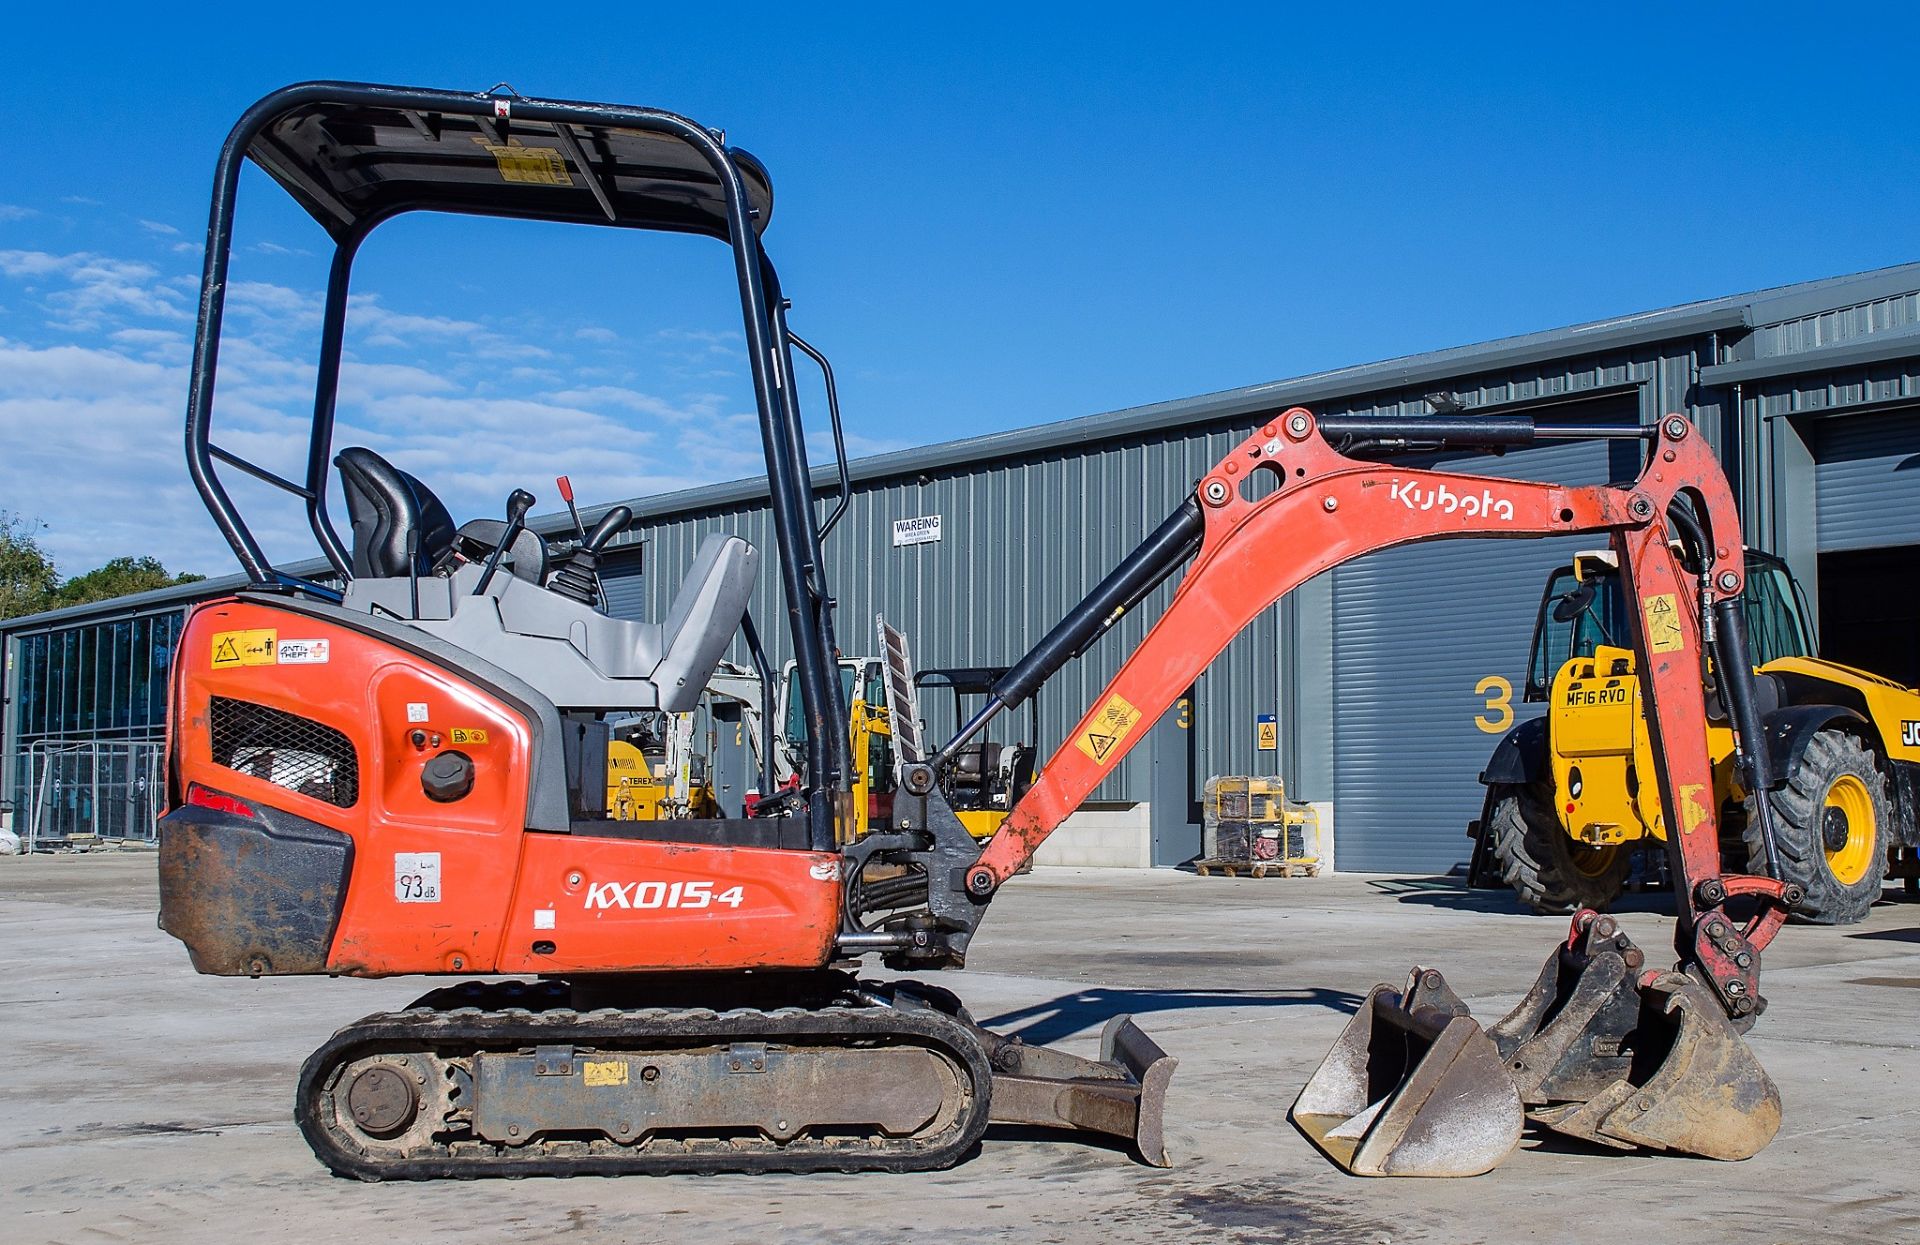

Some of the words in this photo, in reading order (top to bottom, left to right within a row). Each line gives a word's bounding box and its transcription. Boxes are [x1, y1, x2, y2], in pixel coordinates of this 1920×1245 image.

[1390, 479, 1514, 520] Kubota
[896, 516, 940, 533] WAREING
[1474, 675, 1514, 734] 3
[1567, 691, 1596, 706] MF16
[1599, 688, 1625, 703] RVO
[1176, 698, 1194, 729] 3
[629, 777, 653, 785] TEREX
[400, 875, 423, 898] 93
[424, 886, 436, 898] dB
[584, 881, 744, 909] KX015-4
